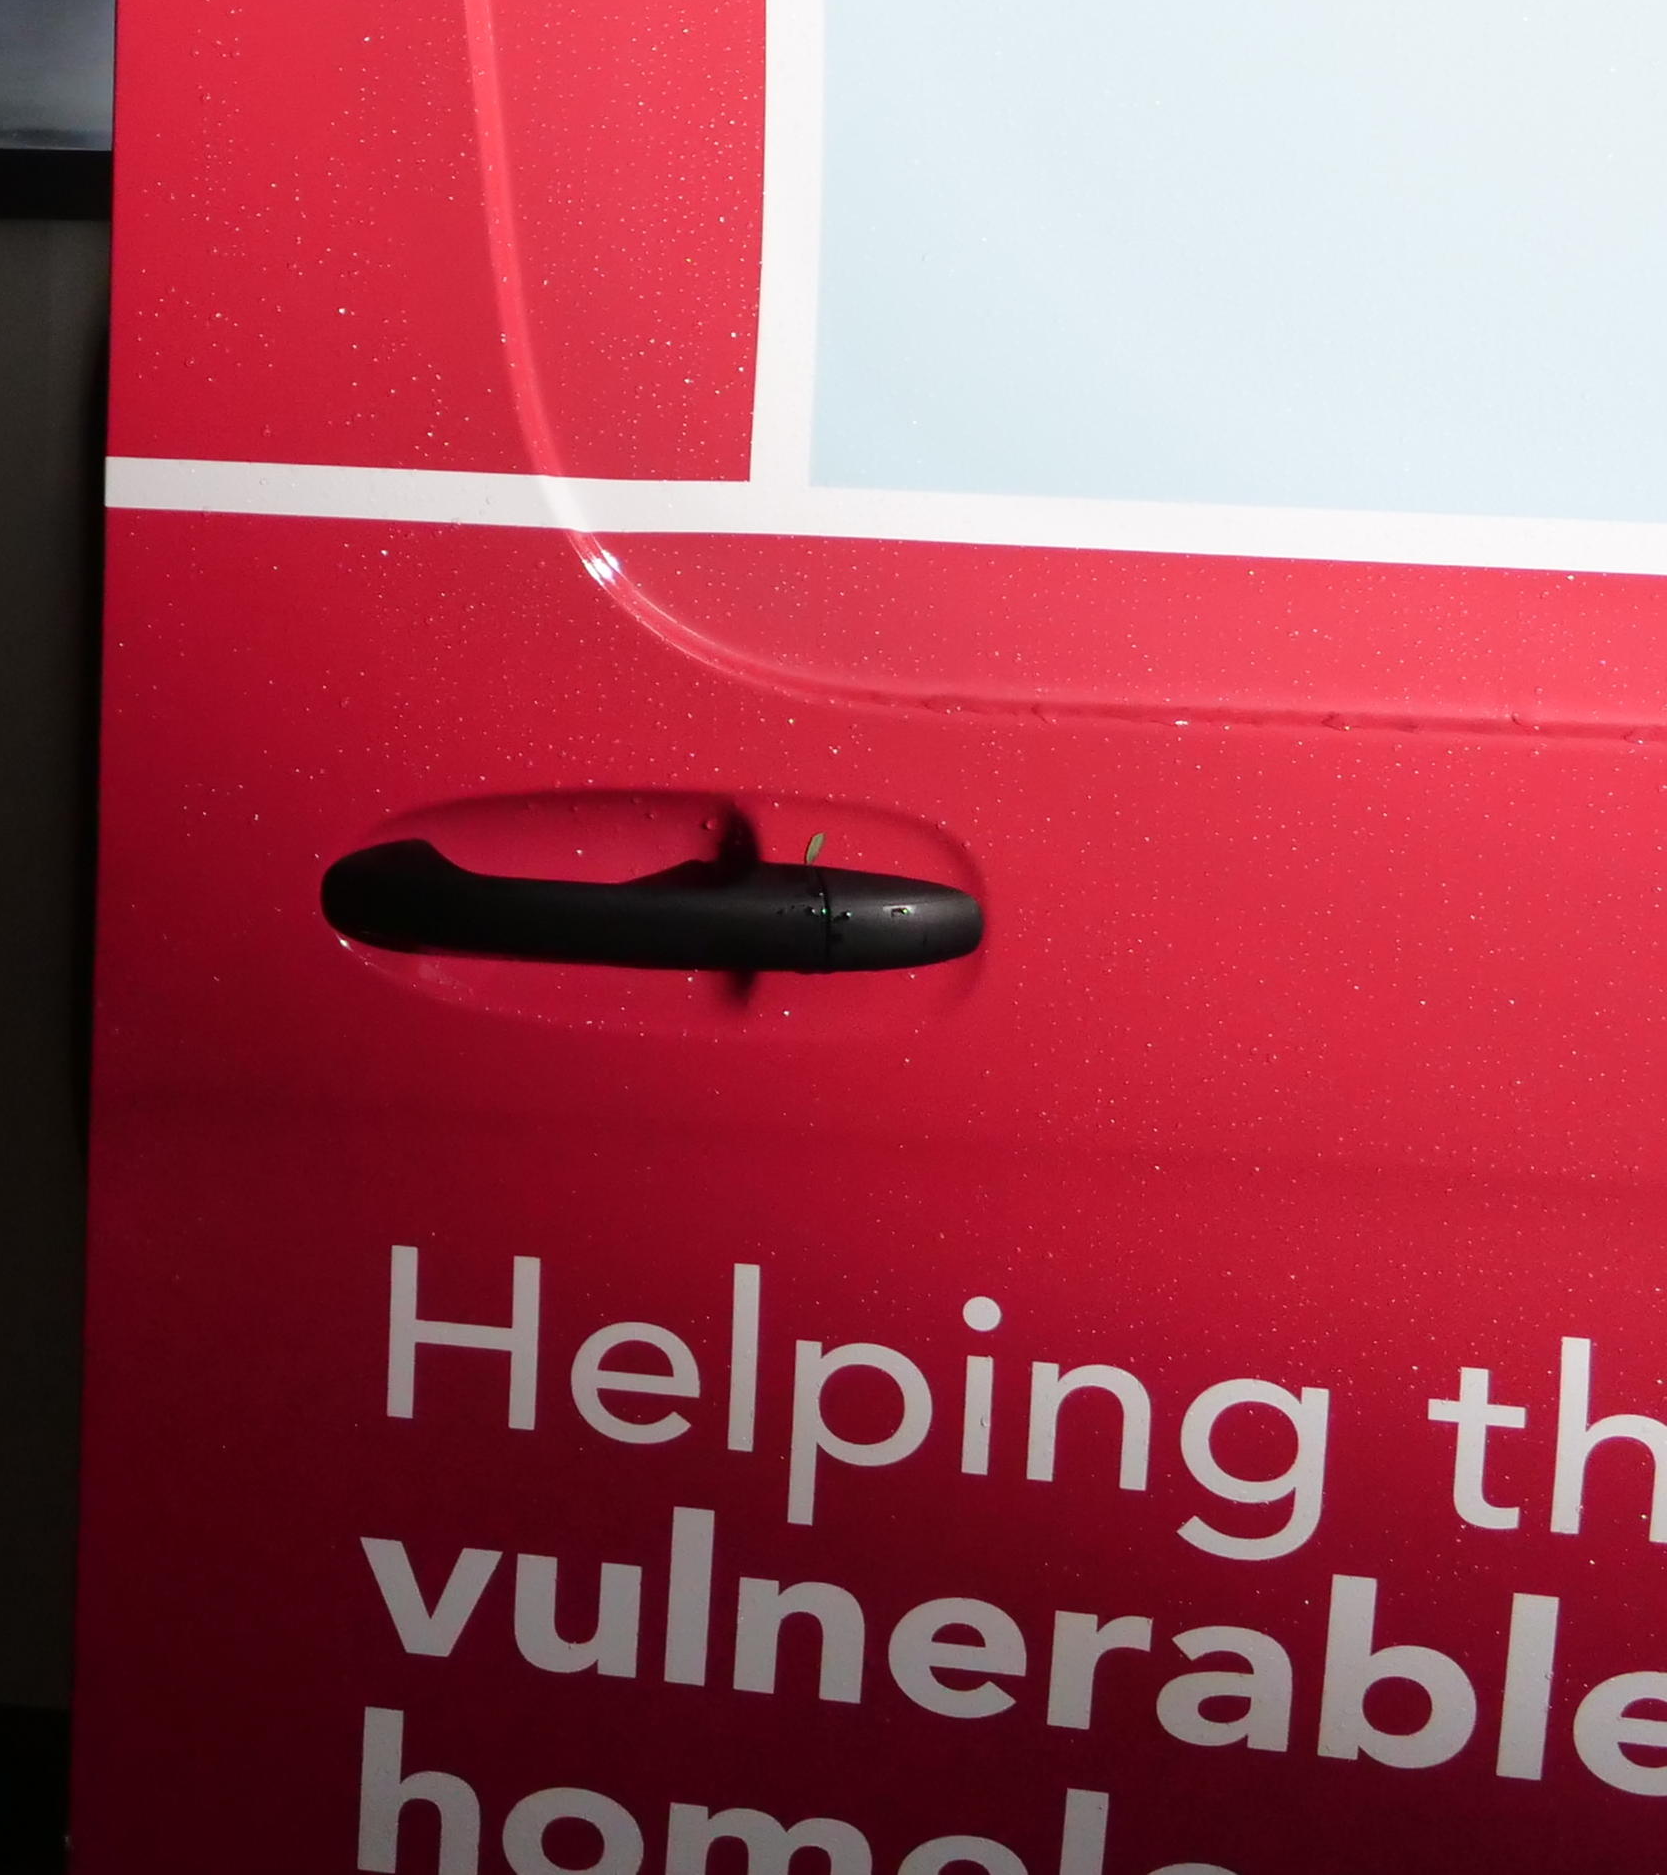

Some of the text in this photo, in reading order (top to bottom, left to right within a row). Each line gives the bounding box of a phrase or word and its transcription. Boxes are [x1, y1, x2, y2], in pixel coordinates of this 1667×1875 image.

[386, 1244, 1667, 1562] Helping th
[357, 1706, 1237, 1875] hom
[360, 1506, 1667, 1797] vulnerable
